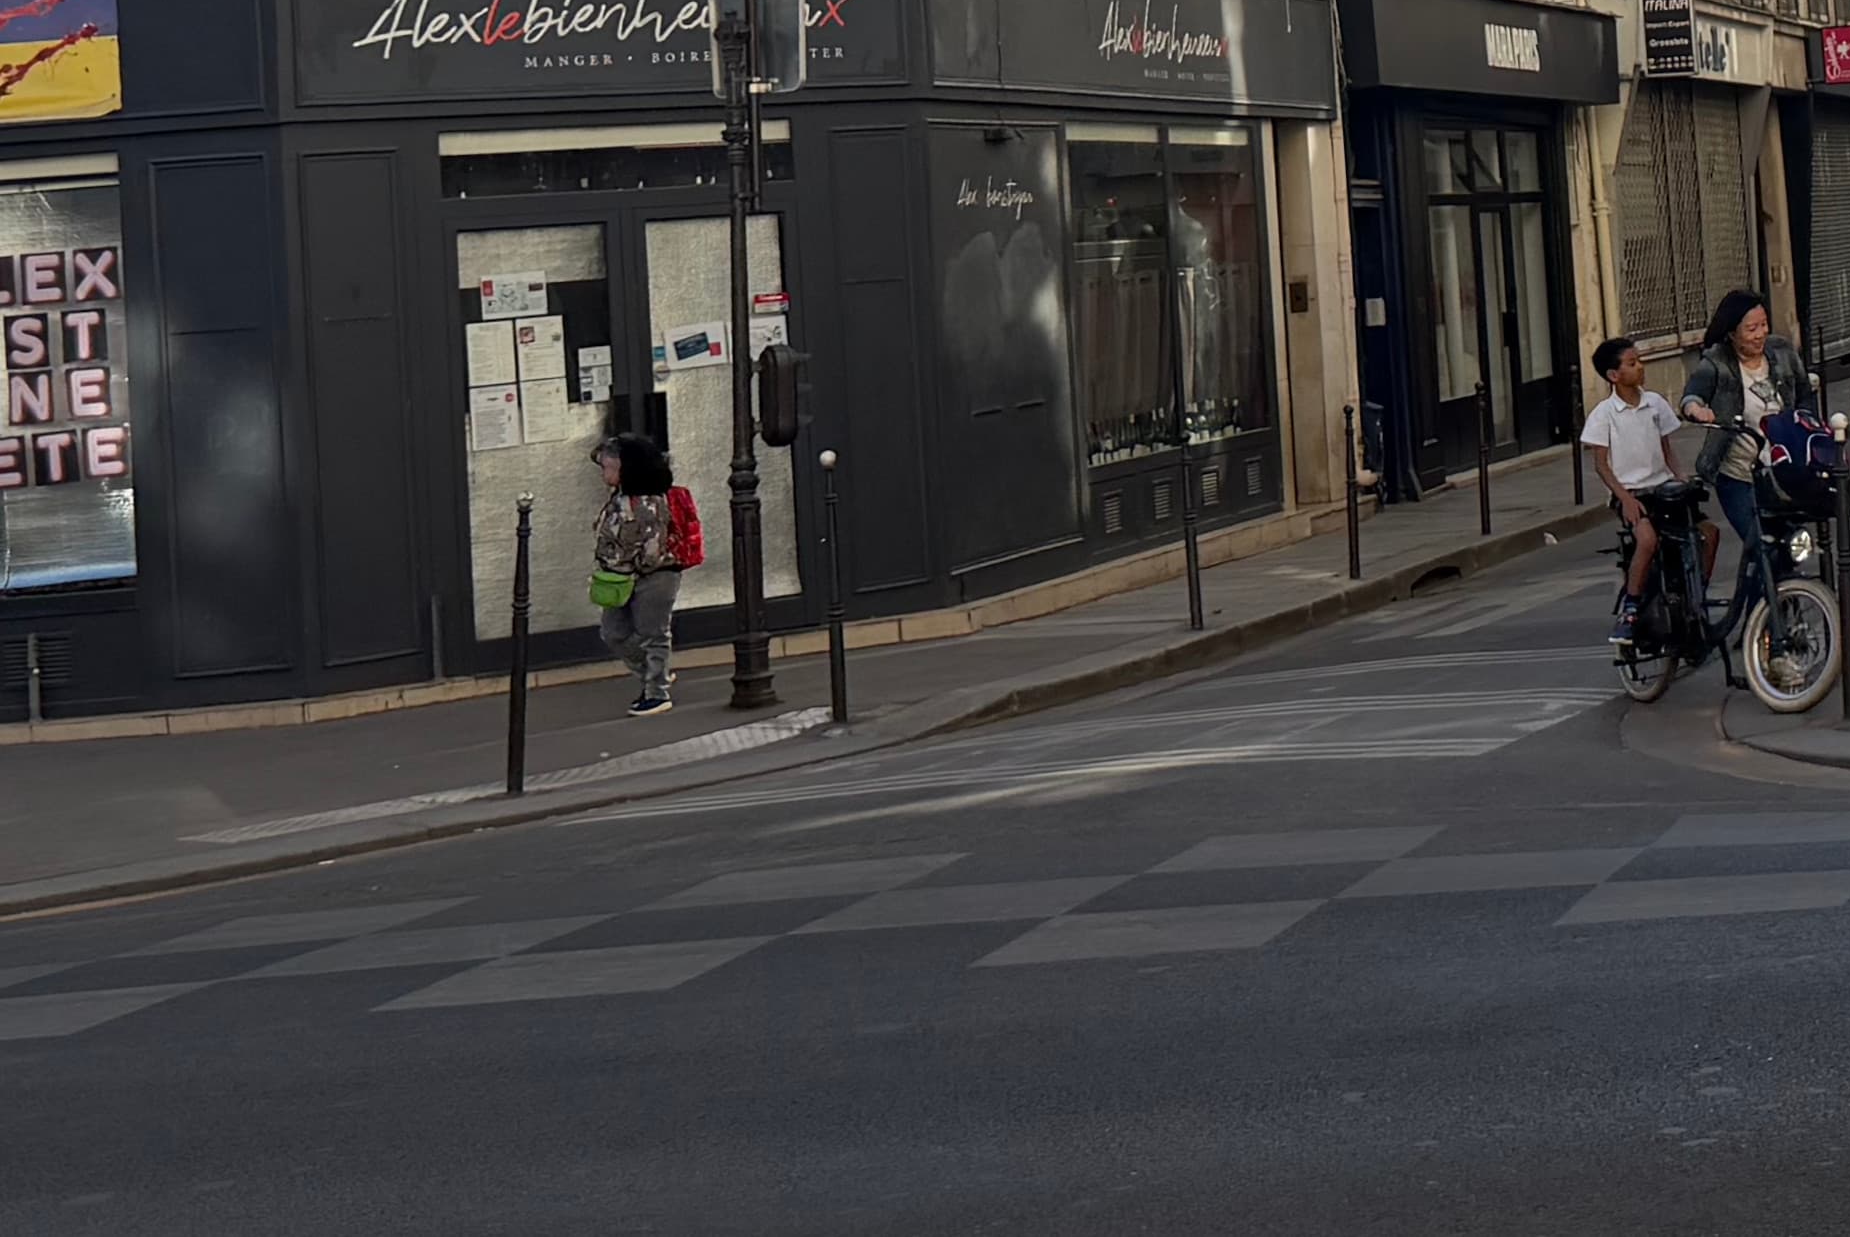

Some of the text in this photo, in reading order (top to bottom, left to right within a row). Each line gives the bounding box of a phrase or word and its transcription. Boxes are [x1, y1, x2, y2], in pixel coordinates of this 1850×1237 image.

[523, 53, 614, 69] MANGER
[651, 49, 713, 63] BOIRE
[0, 249, 118, 305] EX
